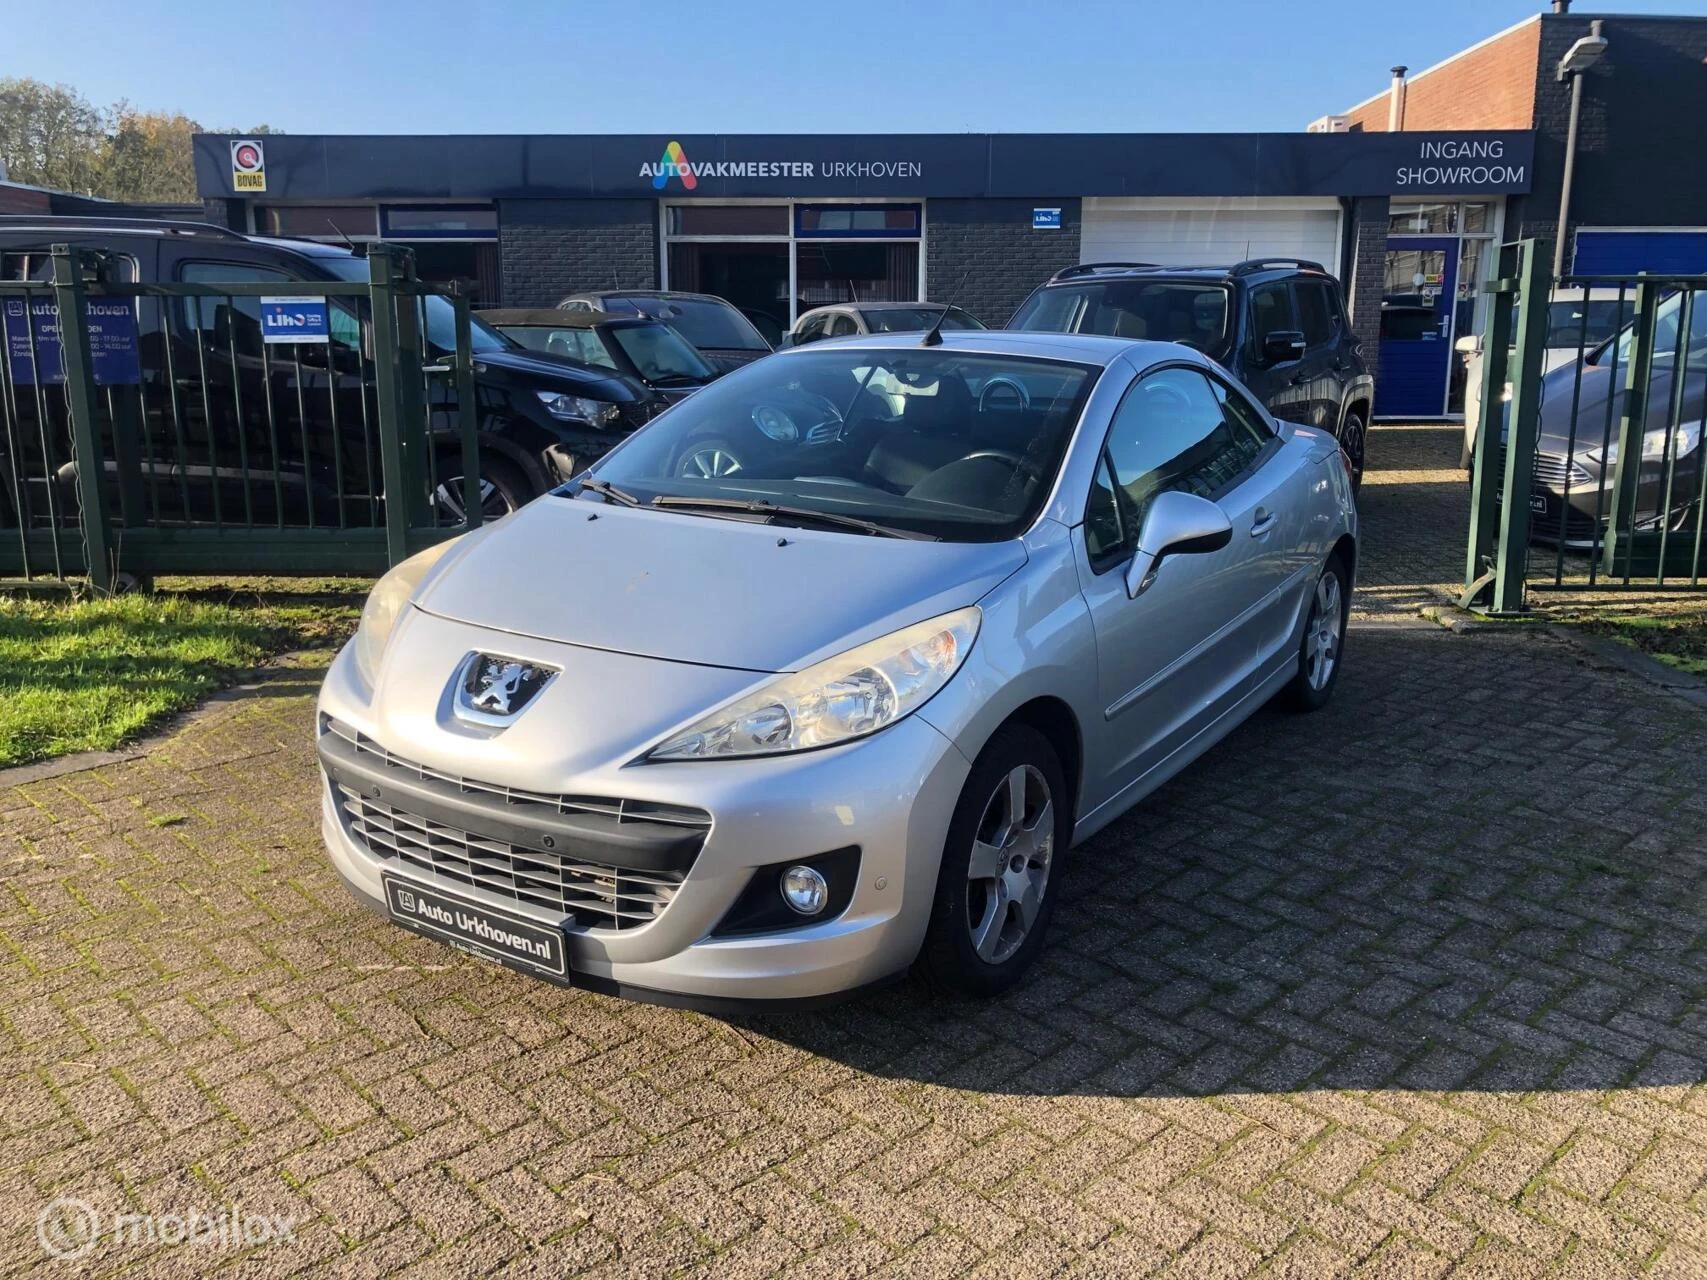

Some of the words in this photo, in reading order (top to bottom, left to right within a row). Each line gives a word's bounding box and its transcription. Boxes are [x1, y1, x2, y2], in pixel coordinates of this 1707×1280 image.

[1420, 140, 1504, 159] INGANG
[638, 162, 815, 178] AUTOVAKMEESTER
[821, 161, 921, 178] URKHOVEN
[1396, 166, 1525, 185] SHOWROOM
[237, 175, 262, 187] BOVAG
[87, 301, 130, 316] hoven
[418, 898, 454, 925] Auto
[455, 911, 551, 960] Urkhoven.nl
